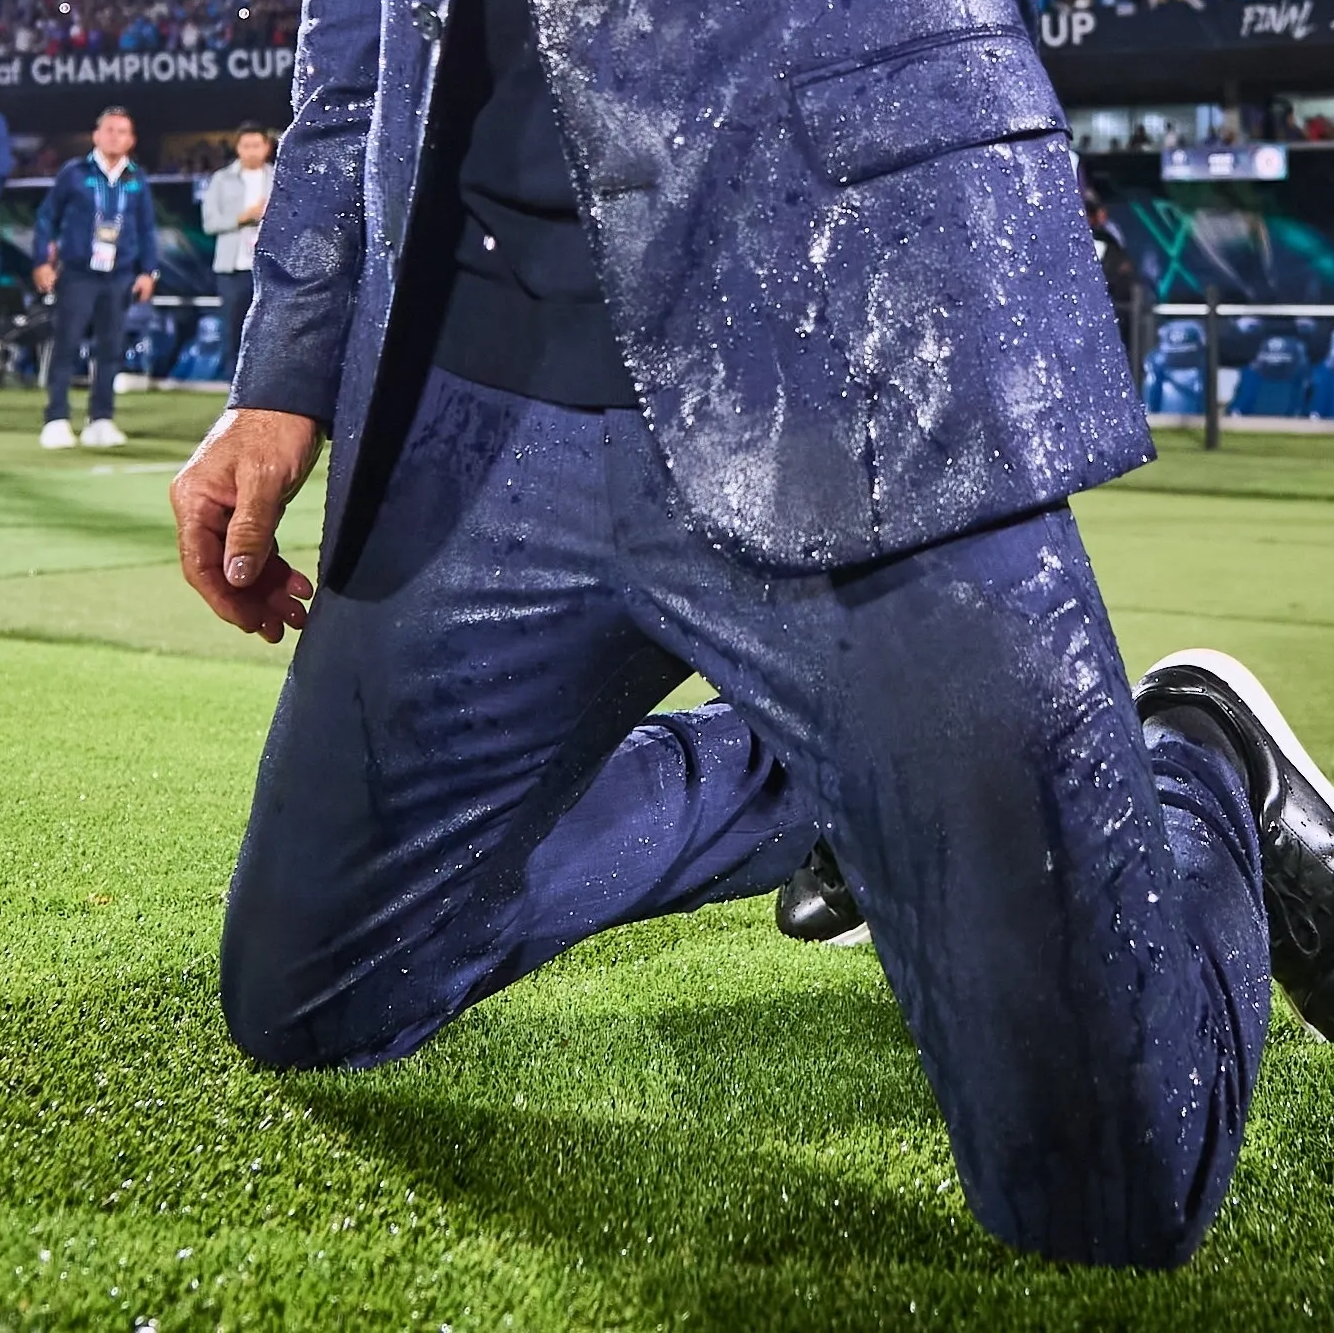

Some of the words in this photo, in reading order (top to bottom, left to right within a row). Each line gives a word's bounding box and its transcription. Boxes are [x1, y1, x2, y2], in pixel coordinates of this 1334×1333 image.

[1041, 11, 1096, 47] UP
[1240, 0, 1316, 39] FINAL
[31, 52, 218, 85] CHAMPIONS
[227, 48, 294, 79] CUP
